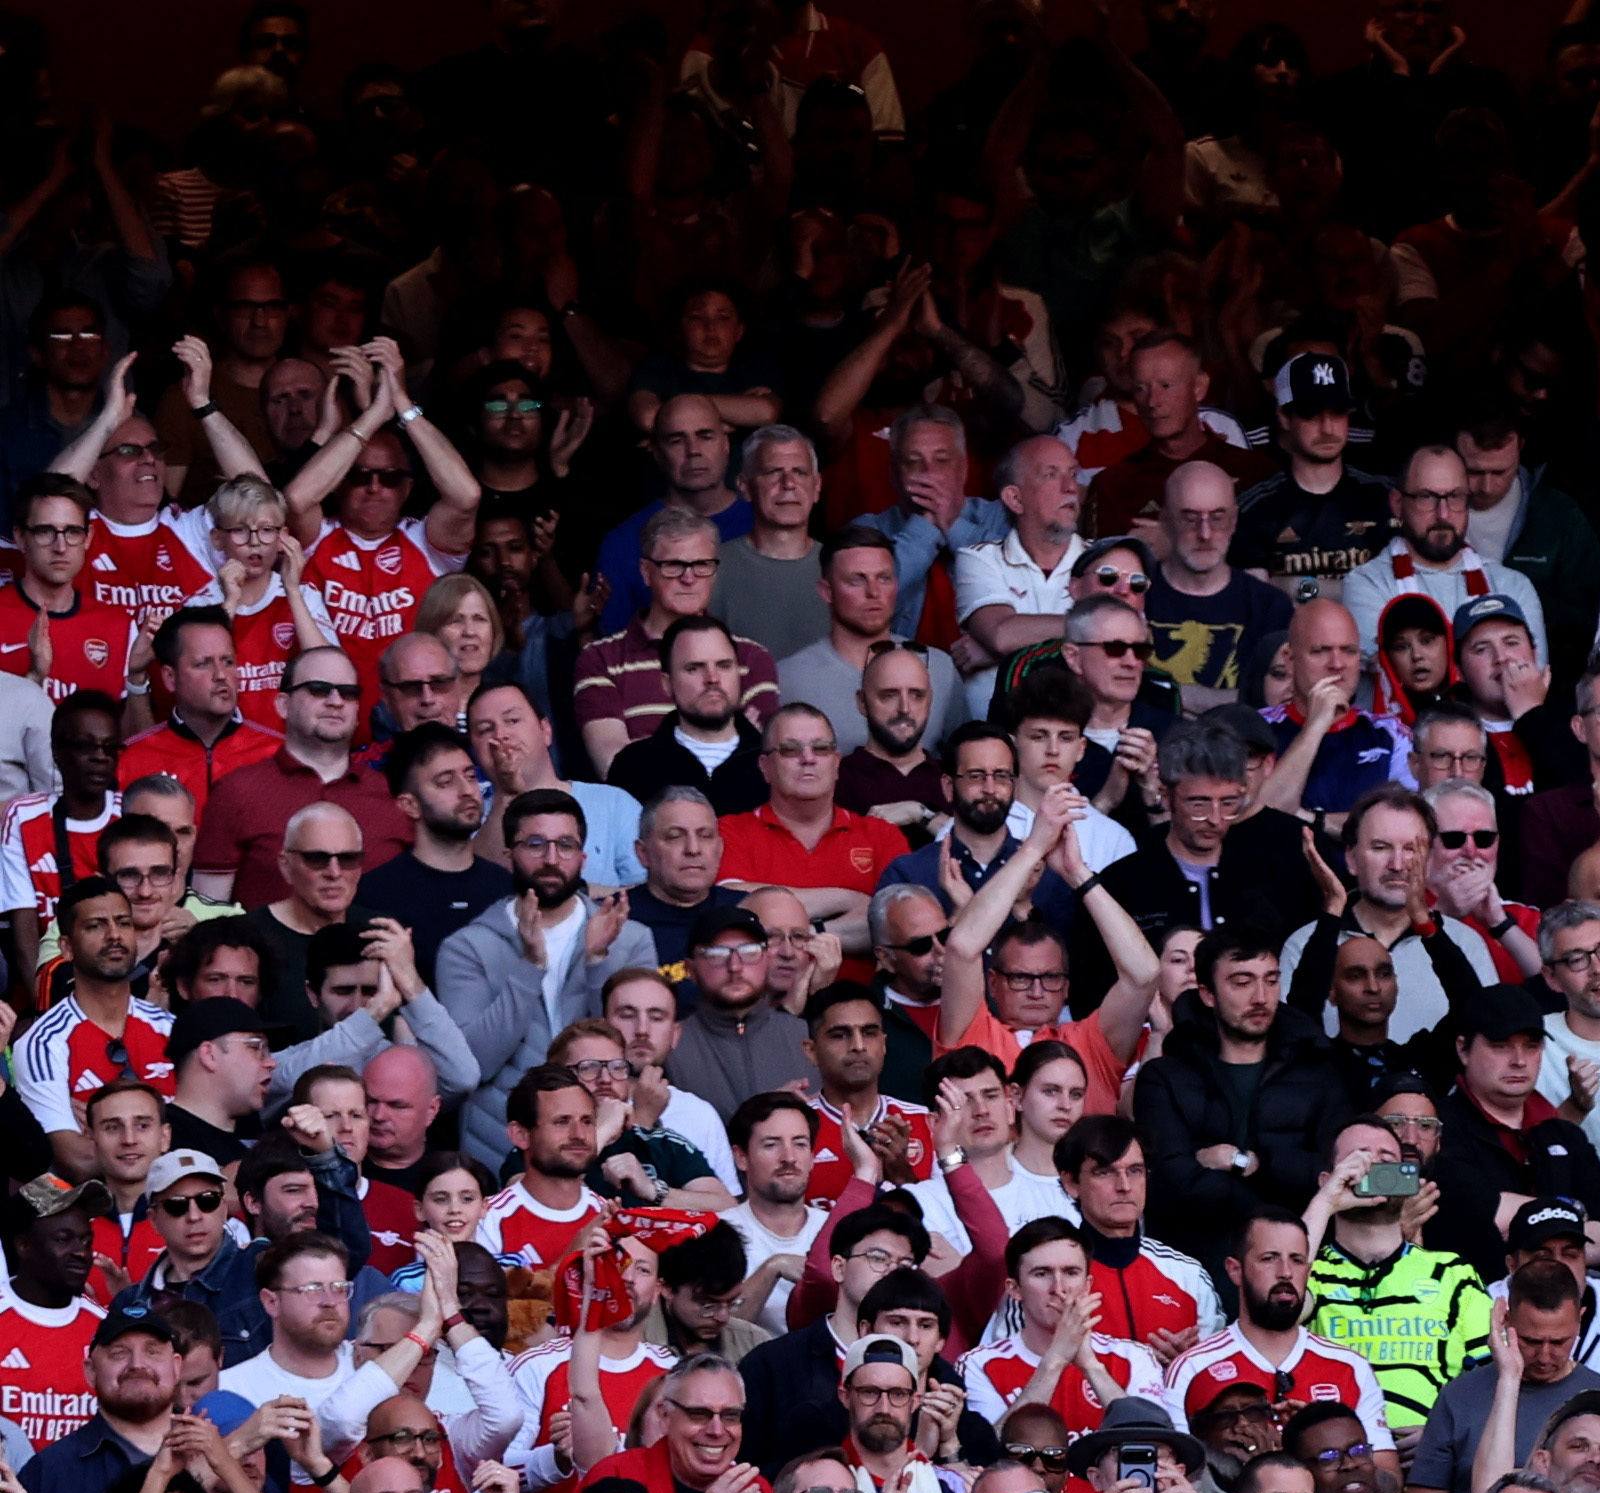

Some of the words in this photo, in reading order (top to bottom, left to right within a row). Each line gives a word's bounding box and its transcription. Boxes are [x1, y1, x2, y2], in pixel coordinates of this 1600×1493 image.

[1528, 1207, 1579, 1225] adidas
[1323, 1313, 1451, 1341] Emirates
[1378, 1340, 1437, 1362] BETTER
